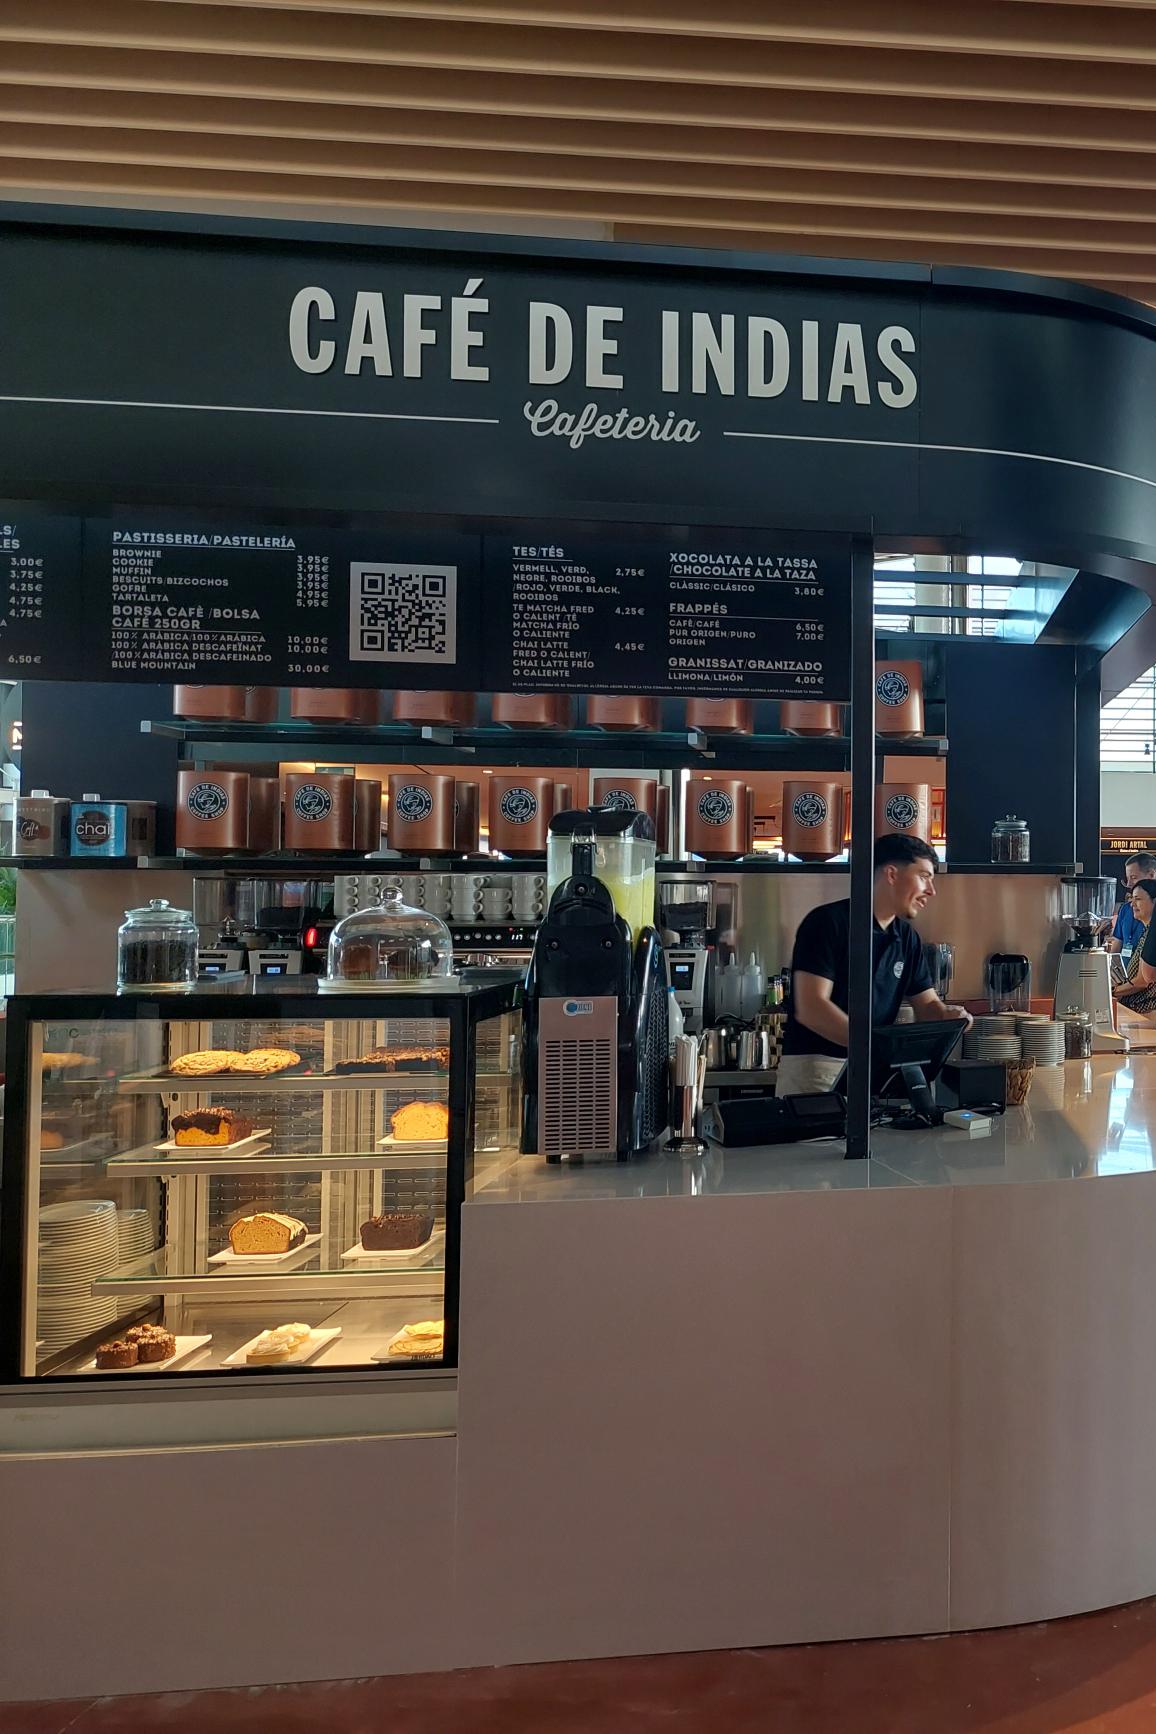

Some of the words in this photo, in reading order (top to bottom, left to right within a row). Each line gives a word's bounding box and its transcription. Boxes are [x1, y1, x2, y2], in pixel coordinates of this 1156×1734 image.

[289, 278, 490, 381] CAFÉ
[528, 301, 624, 390] DE
[661, 310, 918, 408] INDIAS
[523, 399, 700, 449] Cafeteria
[112, 549, 162, 558] BROWNIE
[112, 558, 154, 566] COOKIE
[669, 553, 741, 566] XOCOLATA
[744, 556, 753, 566] A
[758, 556, 773, 567] LA
[777, 557, 818, 569] TASSA
[112, 566, 152, 575] MUFFIN
[754, 568, 763, 578] A
[766, 568, 782, 579] LA
[784, 569, 816, 580] TAZA
[551, 575, 596, 584] ROOIBOS
[112, 584, 147, 593] GOFRE
[112, 593, 169, 602] TARTALETA
[513, 593, 559, 601] ROOIBOS
[112, 605, 162, 616] BORSA
[527, 604, 567, 613] MATCHA
[570, 605, 594, 614] FRED
[669, 602, 728, 614] FRAPPÉS
[523, 612, 560, 621] CALENT
[154, 618, 200, 629] 250GR
[513, 621, 554, 630] MATCHA
[523, 630, 570, 639] CALIENTE
[669, 629, 688, 637] PUR
[513, 640, 538, 648] CHAI
[541, 641, 569, 649] LATTE
[669, 638, 706, 646] ORIGEN
[513, 649, 537, 658] FRED
[112, 660, 137, 669] BLUE
[140, 661, 196, 670] MOUNTAIN
[513, 659, 538, 667] CHAI
[541, 660, 569, 668] LATTE
[668, 657, 823, 672] GRANISSAT/GRANIZADO
[523, 669, 570, 678] CALIENTE
